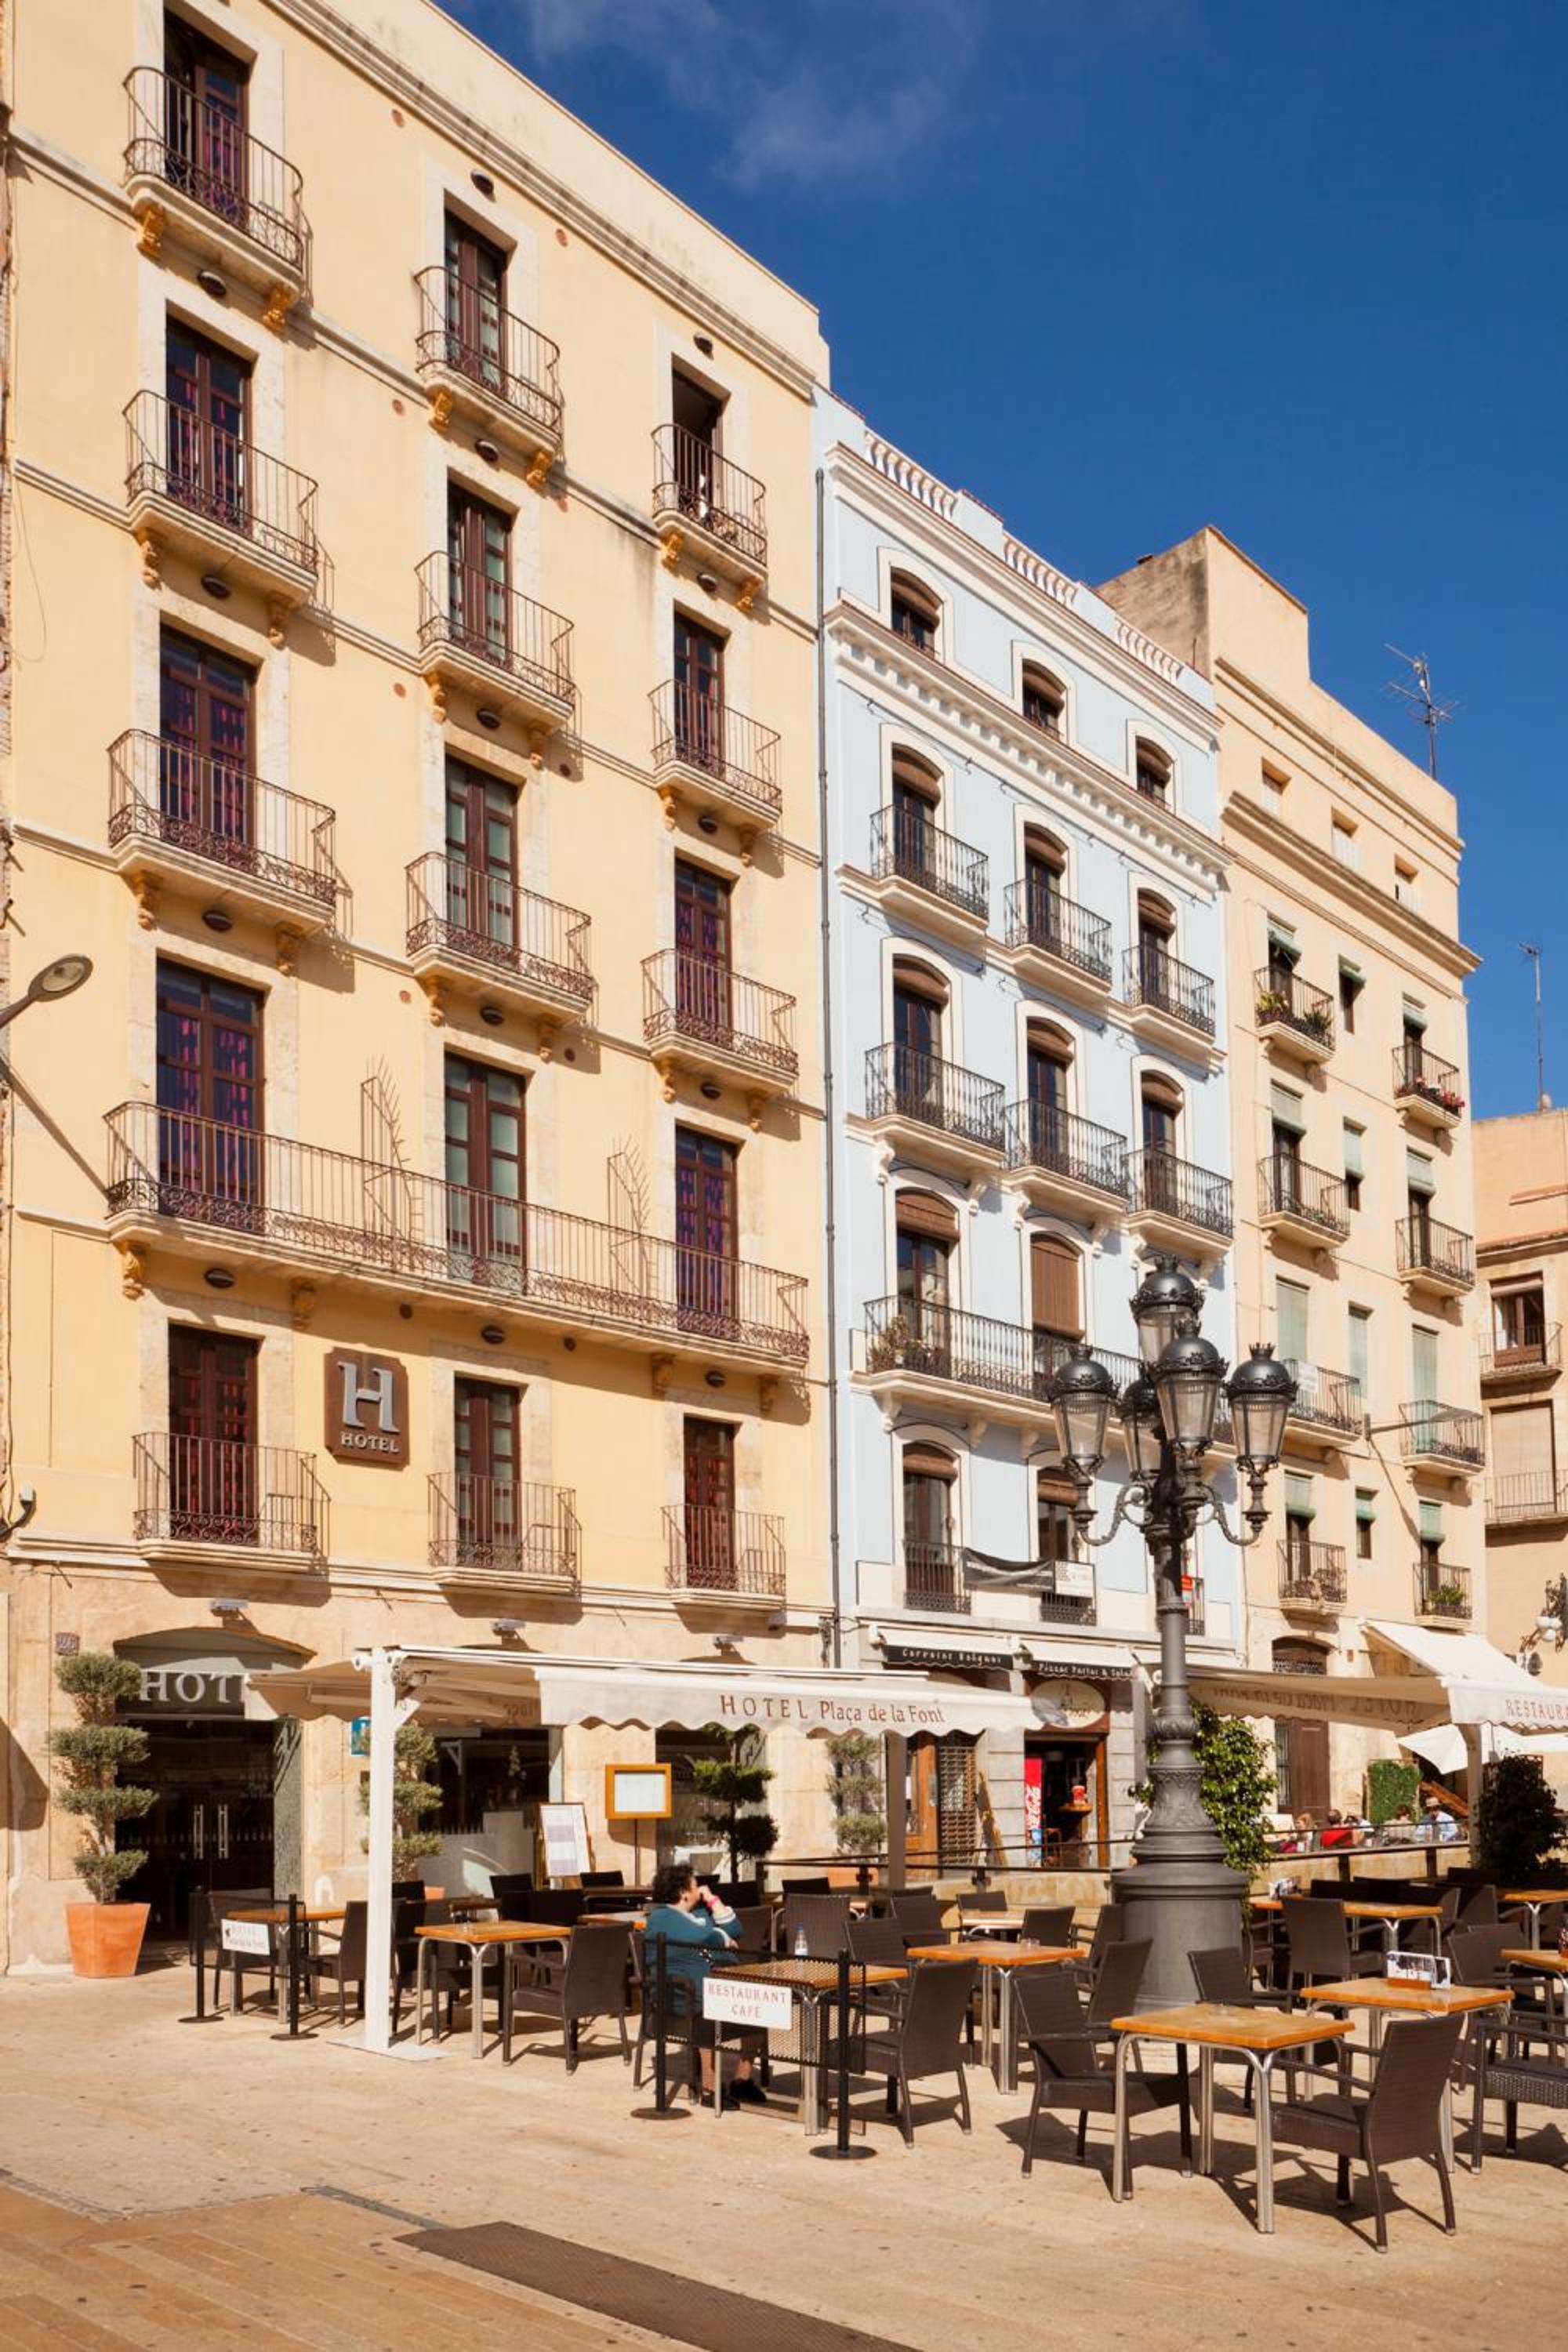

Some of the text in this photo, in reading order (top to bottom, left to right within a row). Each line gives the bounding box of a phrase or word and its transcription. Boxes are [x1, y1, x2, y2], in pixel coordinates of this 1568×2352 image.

[337, 1361, 401, 1433] H
[340, 1432, 399, 1453] HOTEL
[720, 1694, 946, 1725] HOTEL Plaça de la Font
[708, 1983, 786, 2004] RESTAURANT
